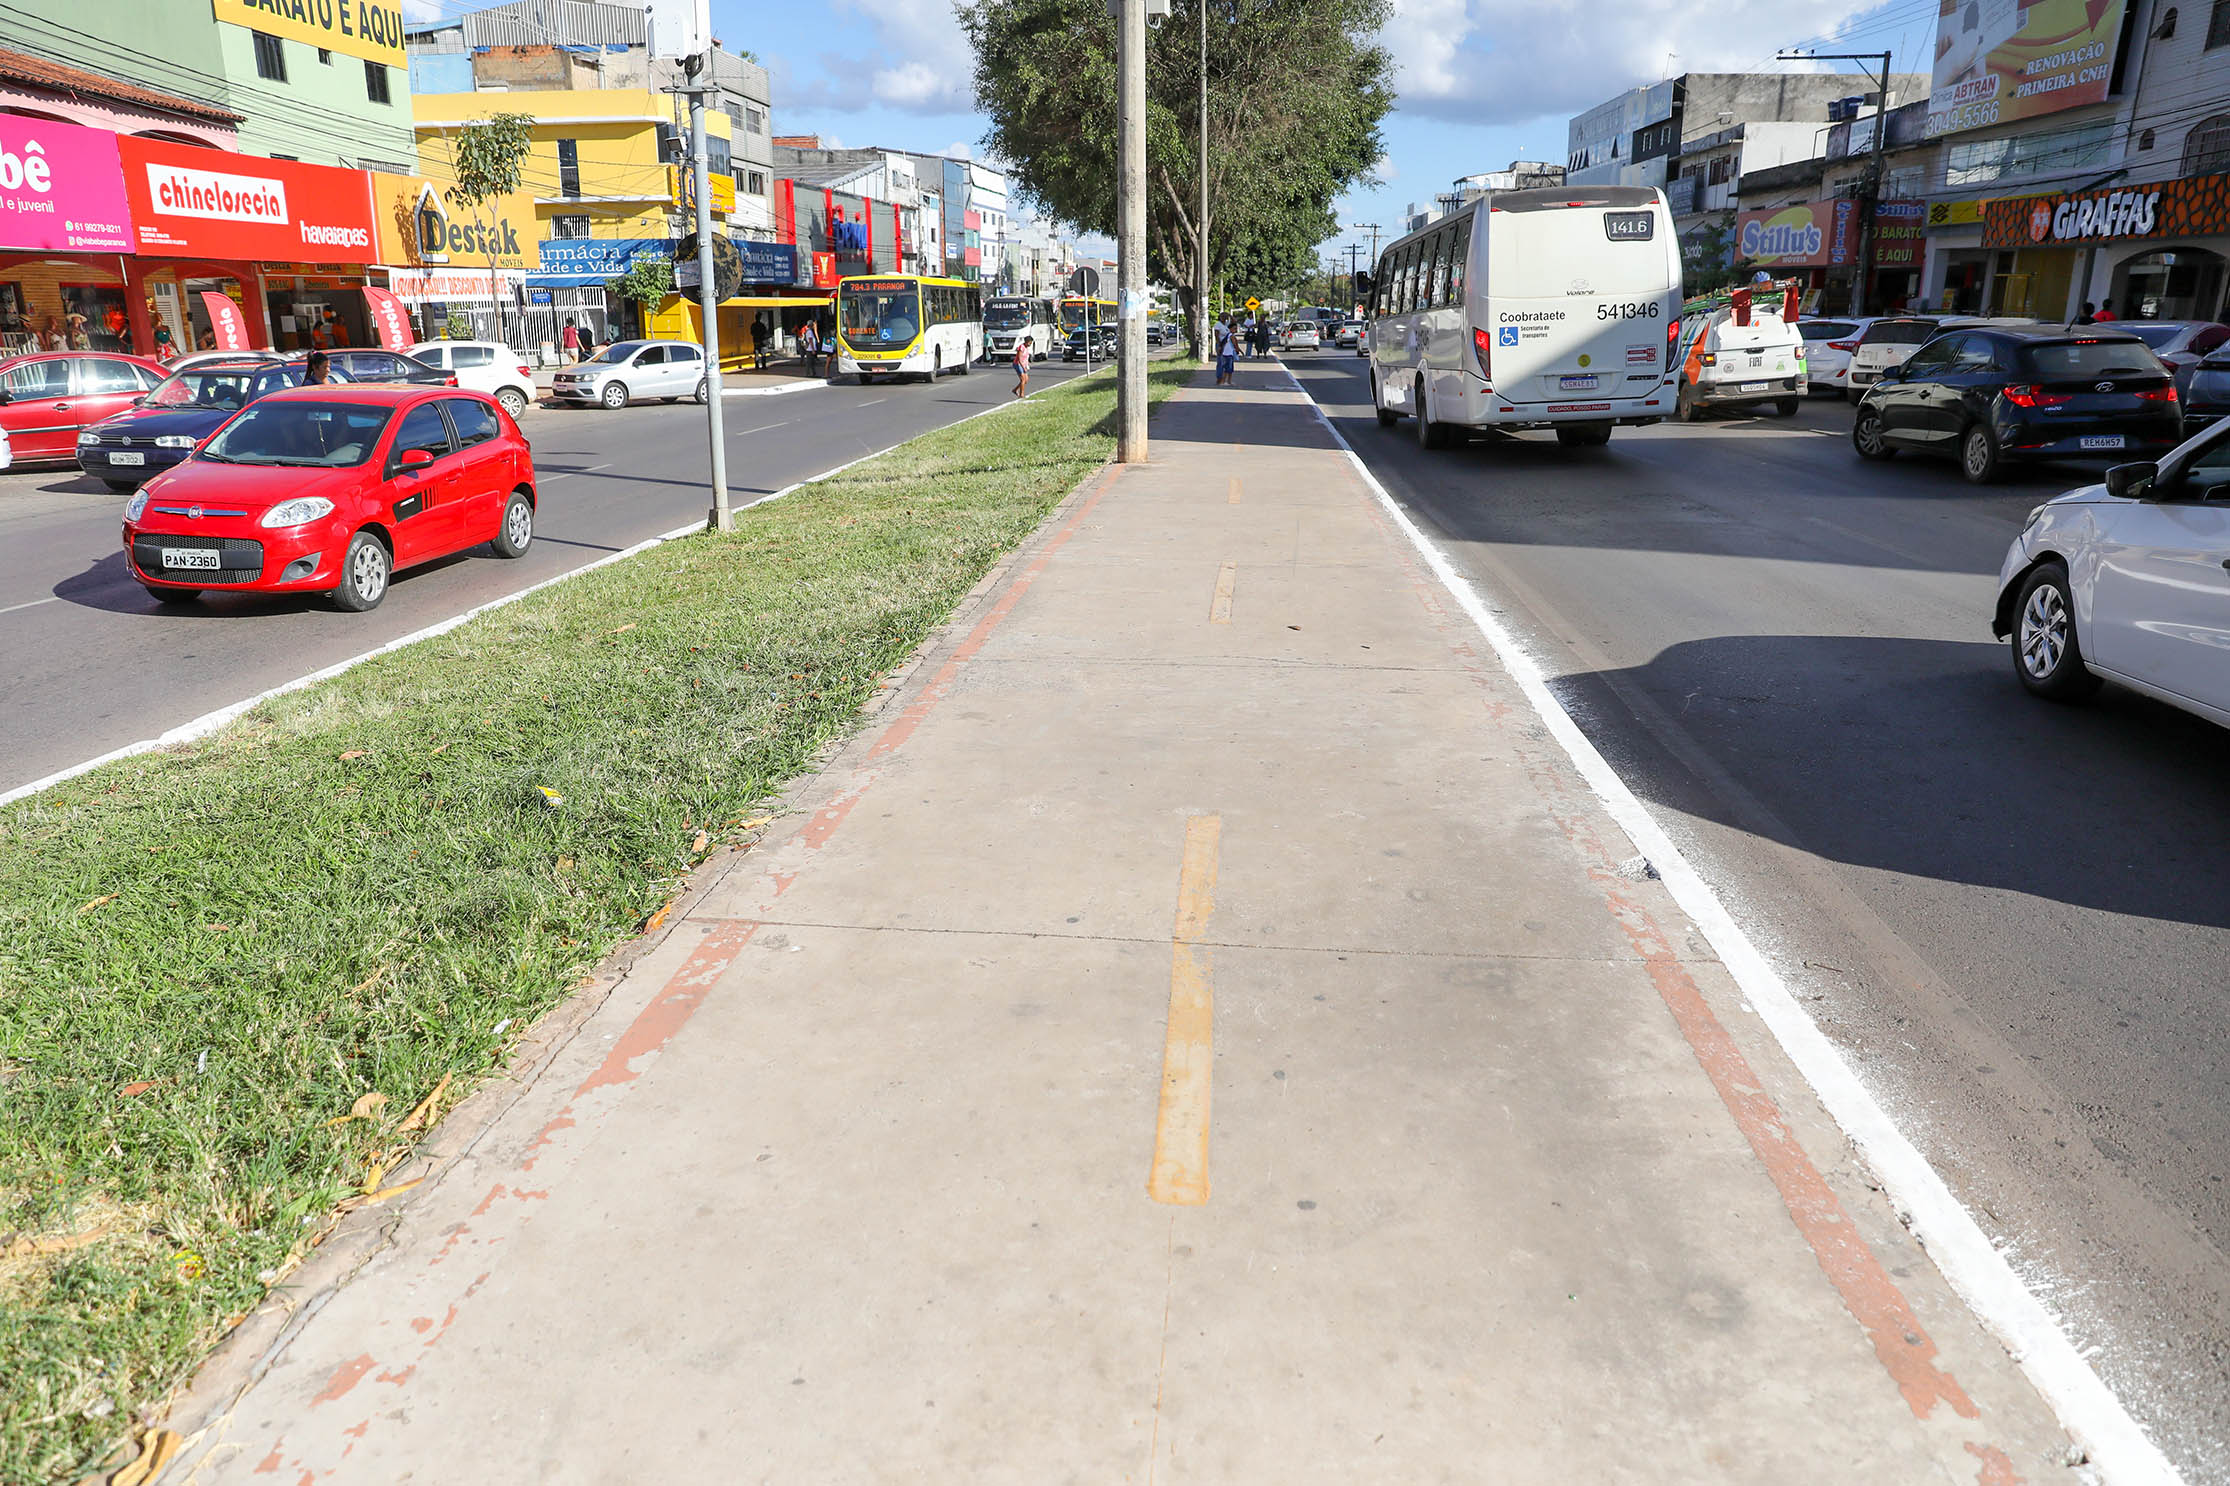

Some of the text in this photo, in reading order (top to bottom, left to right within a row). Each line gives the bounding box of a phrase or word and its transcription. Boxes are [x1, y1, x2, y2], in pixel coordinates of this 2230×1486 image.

[359, 1, 405, 50] AQUI
[2026, 40, 2105, 76] RENOVAÇÃO
[1953, 77, 1996, 101] ABTRAN
[2016, 63, 2108, 99] PRIMEIRA CNH
[1926, 100, 2000, 137] 3049-5566
[16, 197, 55, 213] juvenil
[159, 175, 281, 217] chinelosecia
[300, 220, 368, 248] havaianas
[423, 209, 521, 255] Destak
[1612, 220, 1648, 234] 141.6
[1741, 219, 1822, 257] Stillu's
[539, 243, 621, 261] armácia
[1885, 247, 1913, 262] AQUI
[574, 264, 583, 273] e
[587, 261, 624, 273] Vida
[449, 277, 484, 296] DESCONTO
[1499, 310, 1566, 323] Coobrataete
[1597, 301, 1659, 320] 541346
[1748, 356, 1763, 368] FIAT
